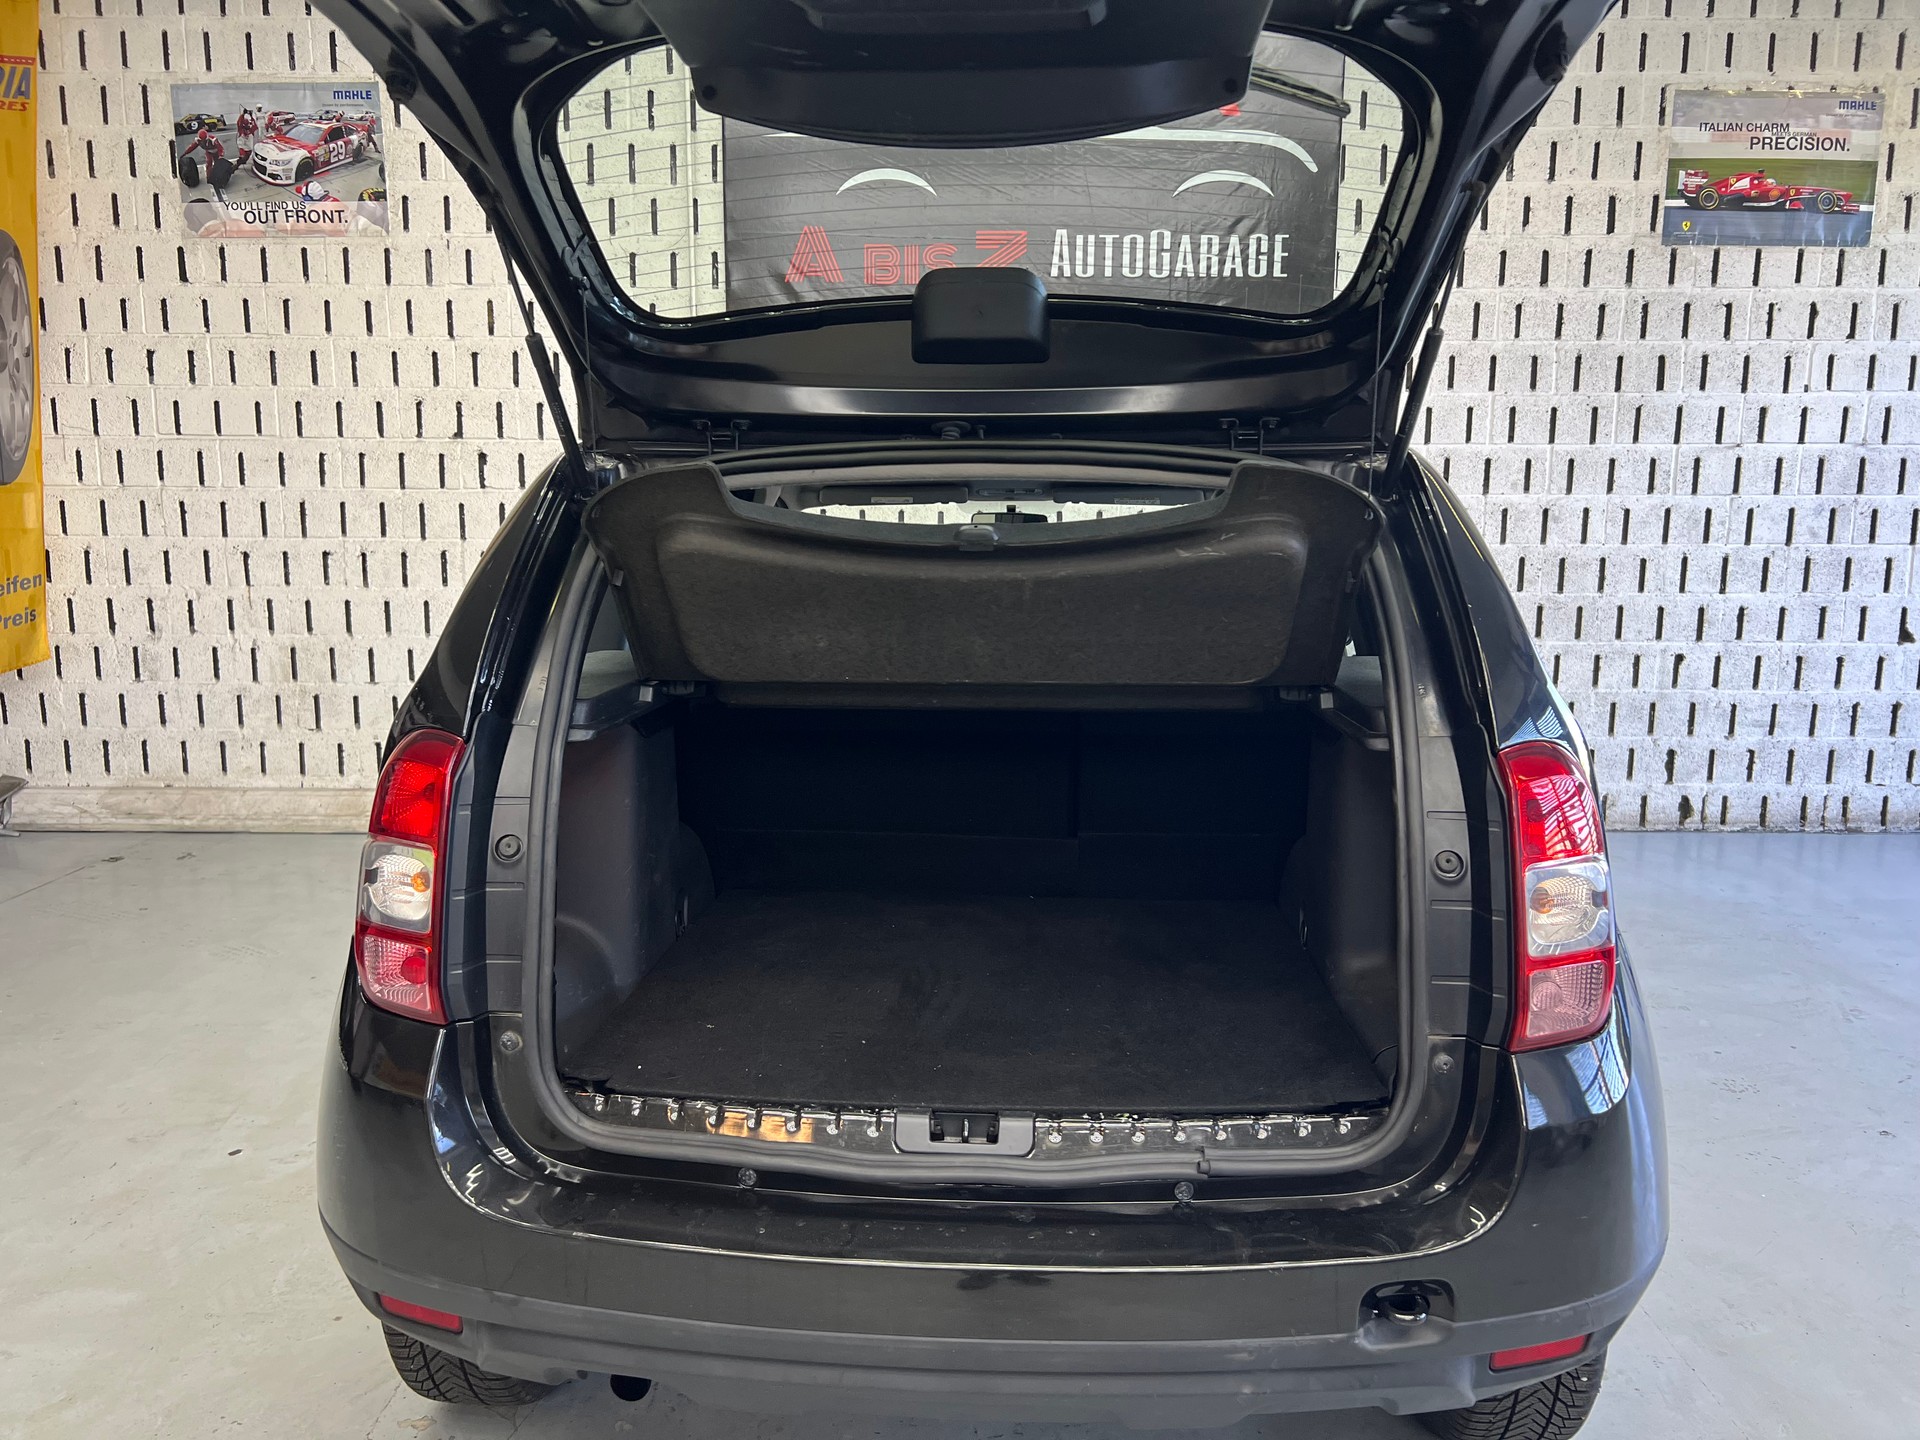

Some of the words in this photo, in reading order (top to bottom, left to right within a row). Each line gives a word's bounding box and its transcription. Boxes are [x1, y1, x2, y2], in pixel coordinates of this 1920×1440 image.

[333, 90, 372, 100] MAHLE
[1838, 100, 1877, 110] MAHLE
[1699, 122, 1743, 132] ITALIAN
[1746, 122, 1790, 133] CHARM
[330, 141, 346, 162] 29
[1750, 136, 1851, 152] PRECISION.
[224, 201, 263, 211] YOU'LL
[265, 201, 288, 210] FIND
[291, 201, 307, 210] US
[243, 210, 279, 224] OUT
[284, 209, 349, 224] FRONT.
[784, 225, 845, 283] A
[863, 243, 959, 285] BIS
[0, 607, 37, 629] reis
